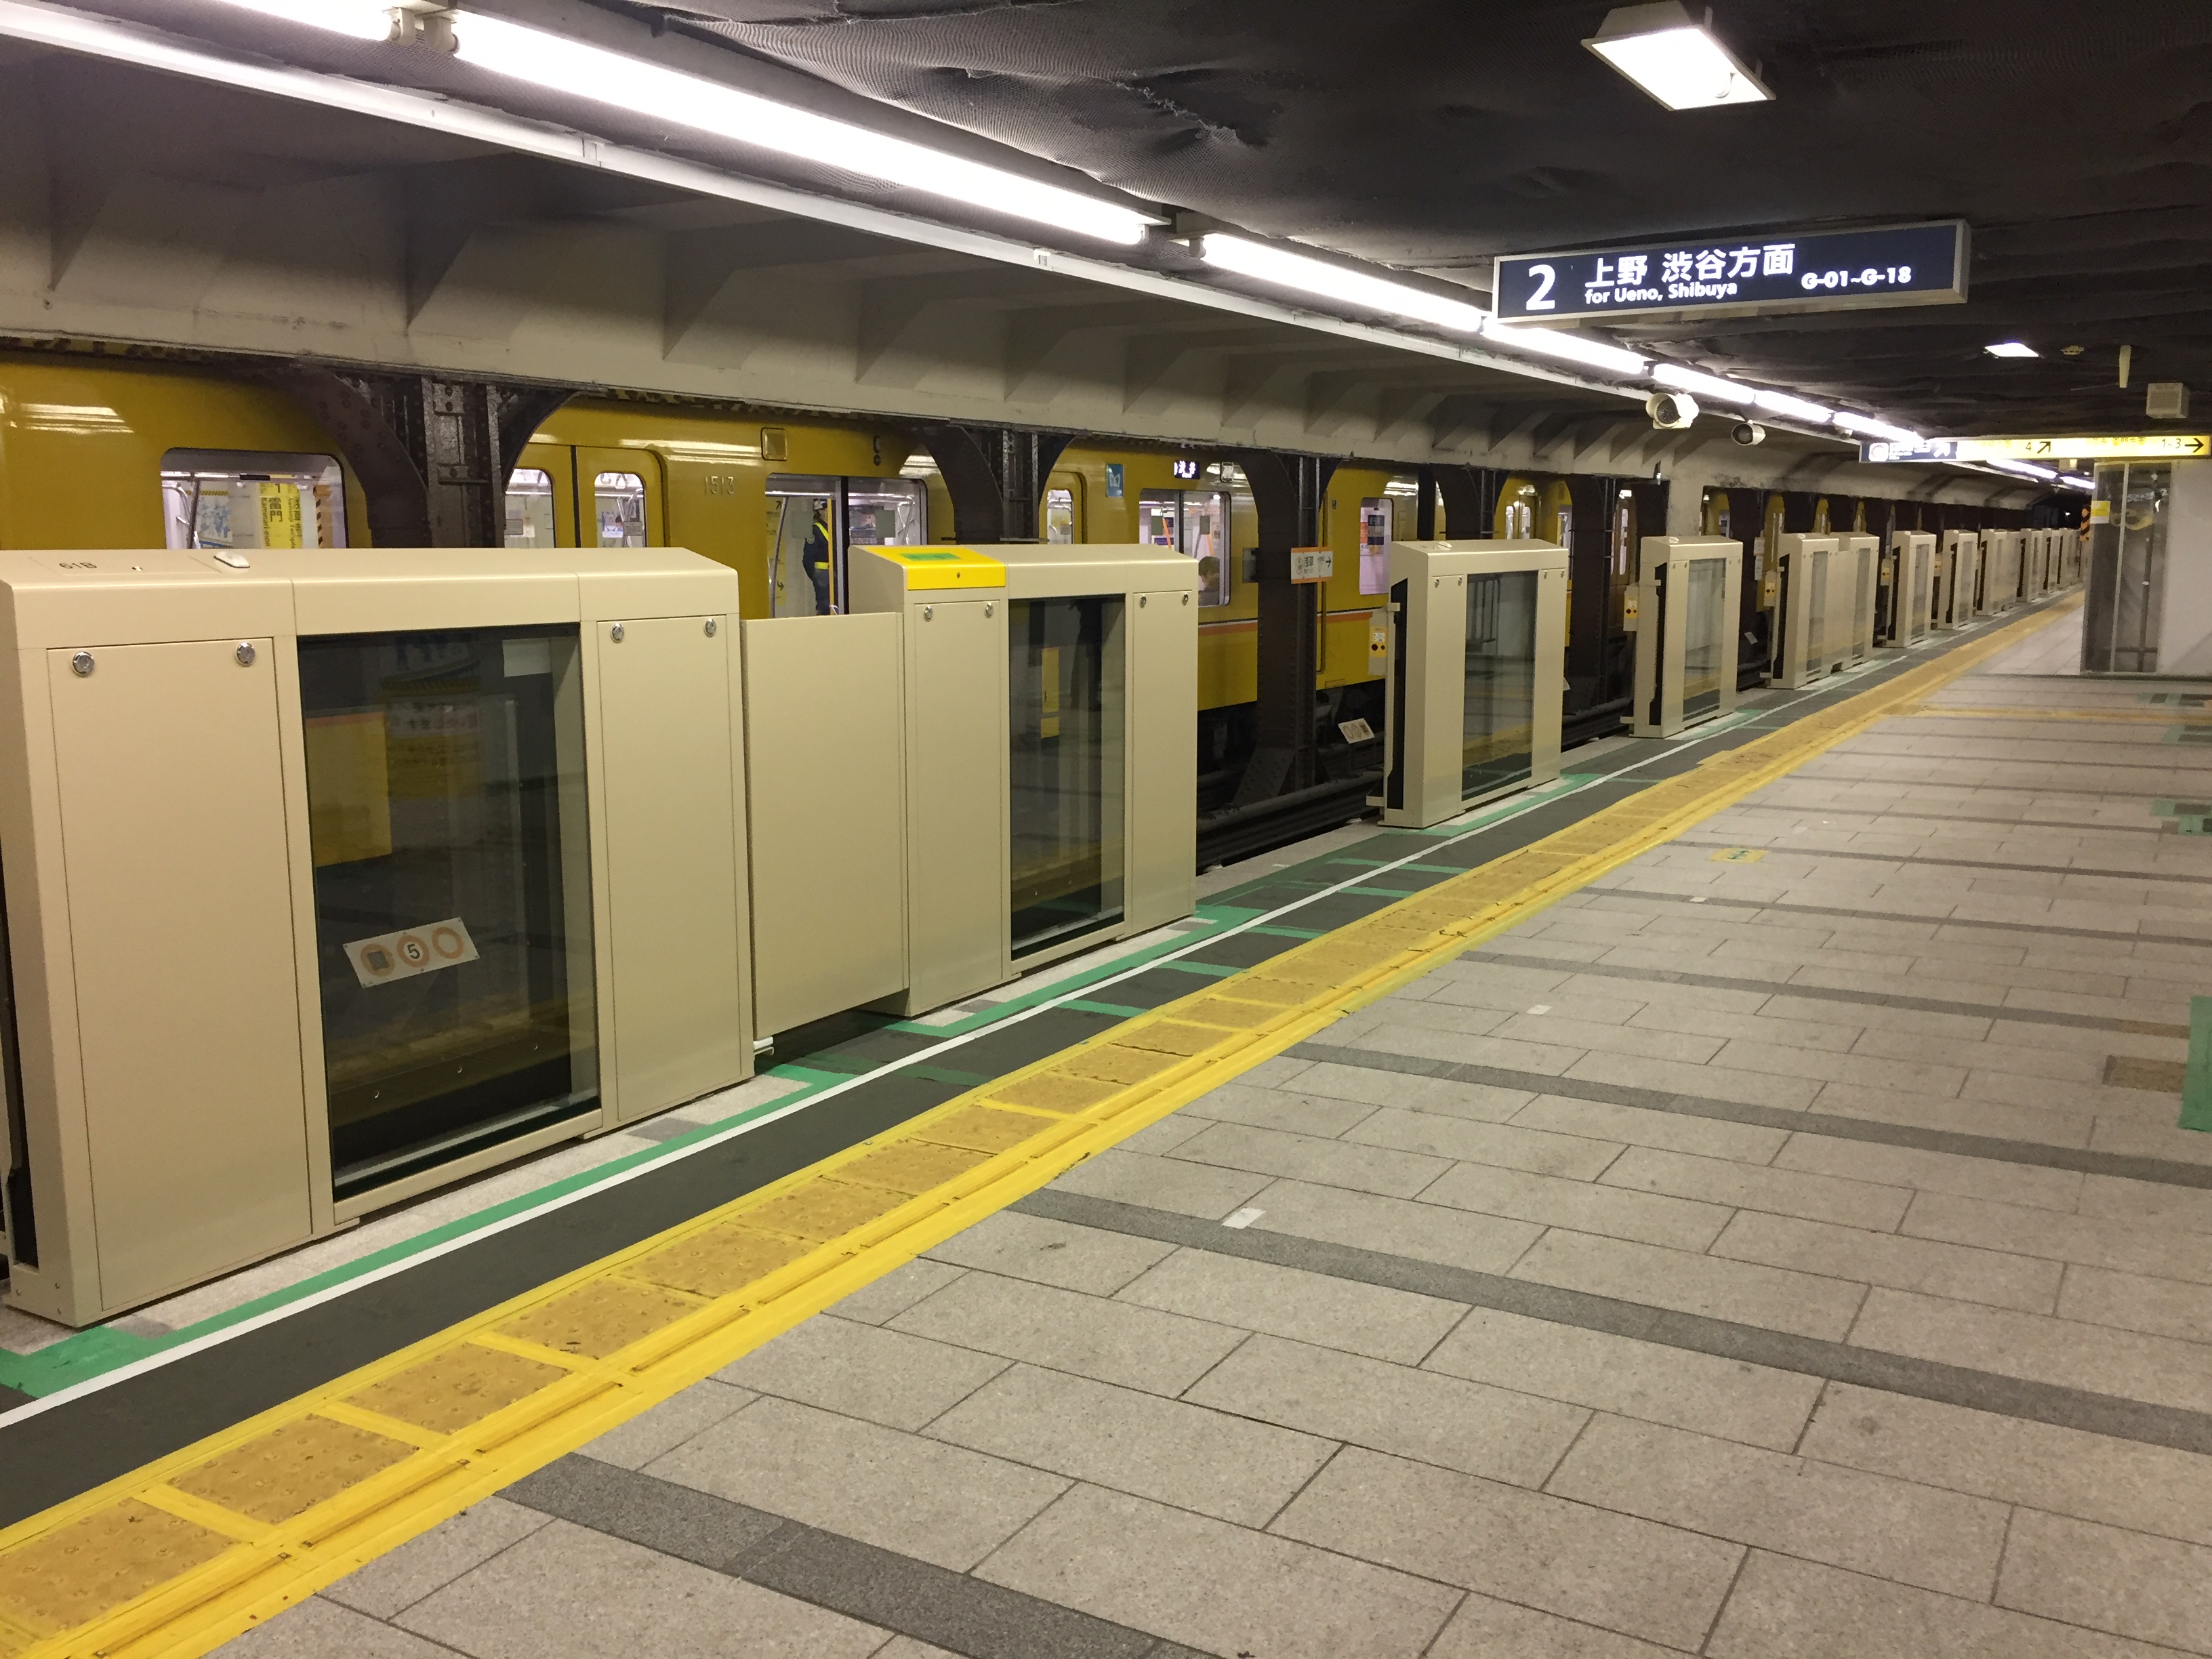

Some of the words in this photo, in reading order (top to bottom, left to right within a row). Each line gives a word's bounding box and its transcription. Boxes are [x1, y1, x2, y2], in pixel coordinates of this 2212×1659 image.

[1584, 255, 1647, 288] 上野
[1661, 243, 1795, 283] 渋谷方面
[1526, 264, 1555, 310] 2
[1585, 288, 1611, 304] for
[1614, 287, 1663, 302] Ueno,
[1668, 281, 1738, 300] Shibuya
[2025, 441, 2032, 451] 4
[705, 476, 734, 495] 1513
[269, 497, 283, 522] 雷門
[407, 943, 420, 960] 5
